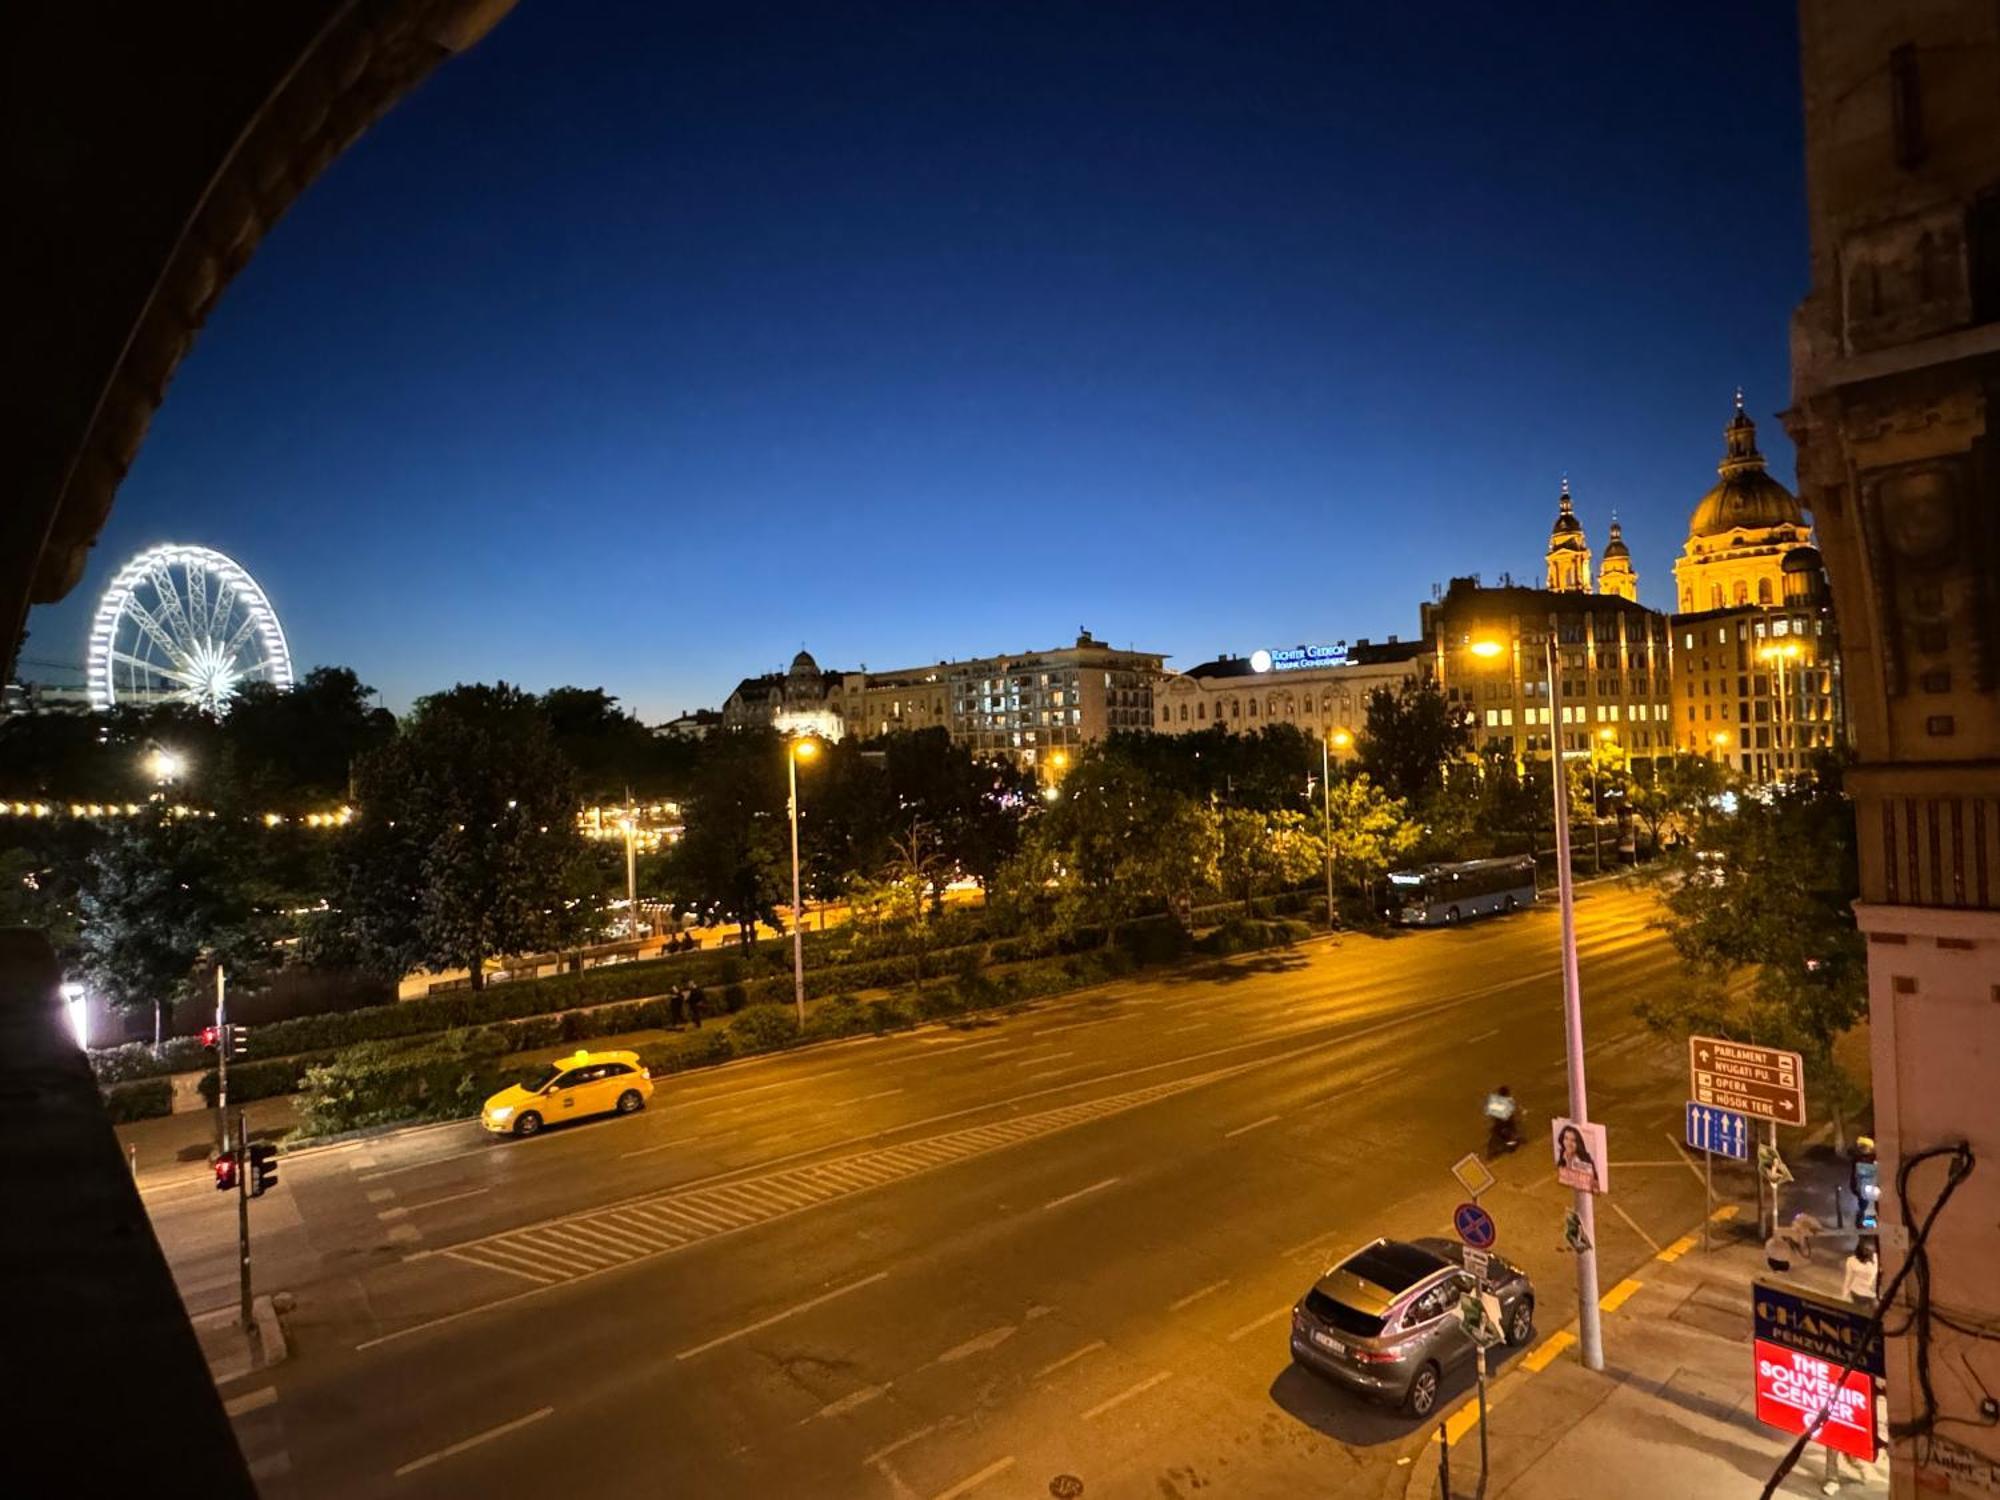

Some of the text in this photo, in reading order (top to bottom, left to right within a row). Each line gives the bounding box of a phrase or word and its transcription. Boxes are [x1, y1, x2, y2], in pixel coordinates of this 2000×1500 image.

[1714, 1045, 1767, 1063] PARLAMENT
[1715, 1061, 1752, 1077] NYUGATI
[1716, 1078, 1747, 1092] OPERA
[1752, 1101, 1774, 1115] TERE
[1792, 1353, 1829, 1380] THE
[1760, 1360, 1866, 1409] SOUVENIR
[1772, 1381, 1854, 1422] CENTER
